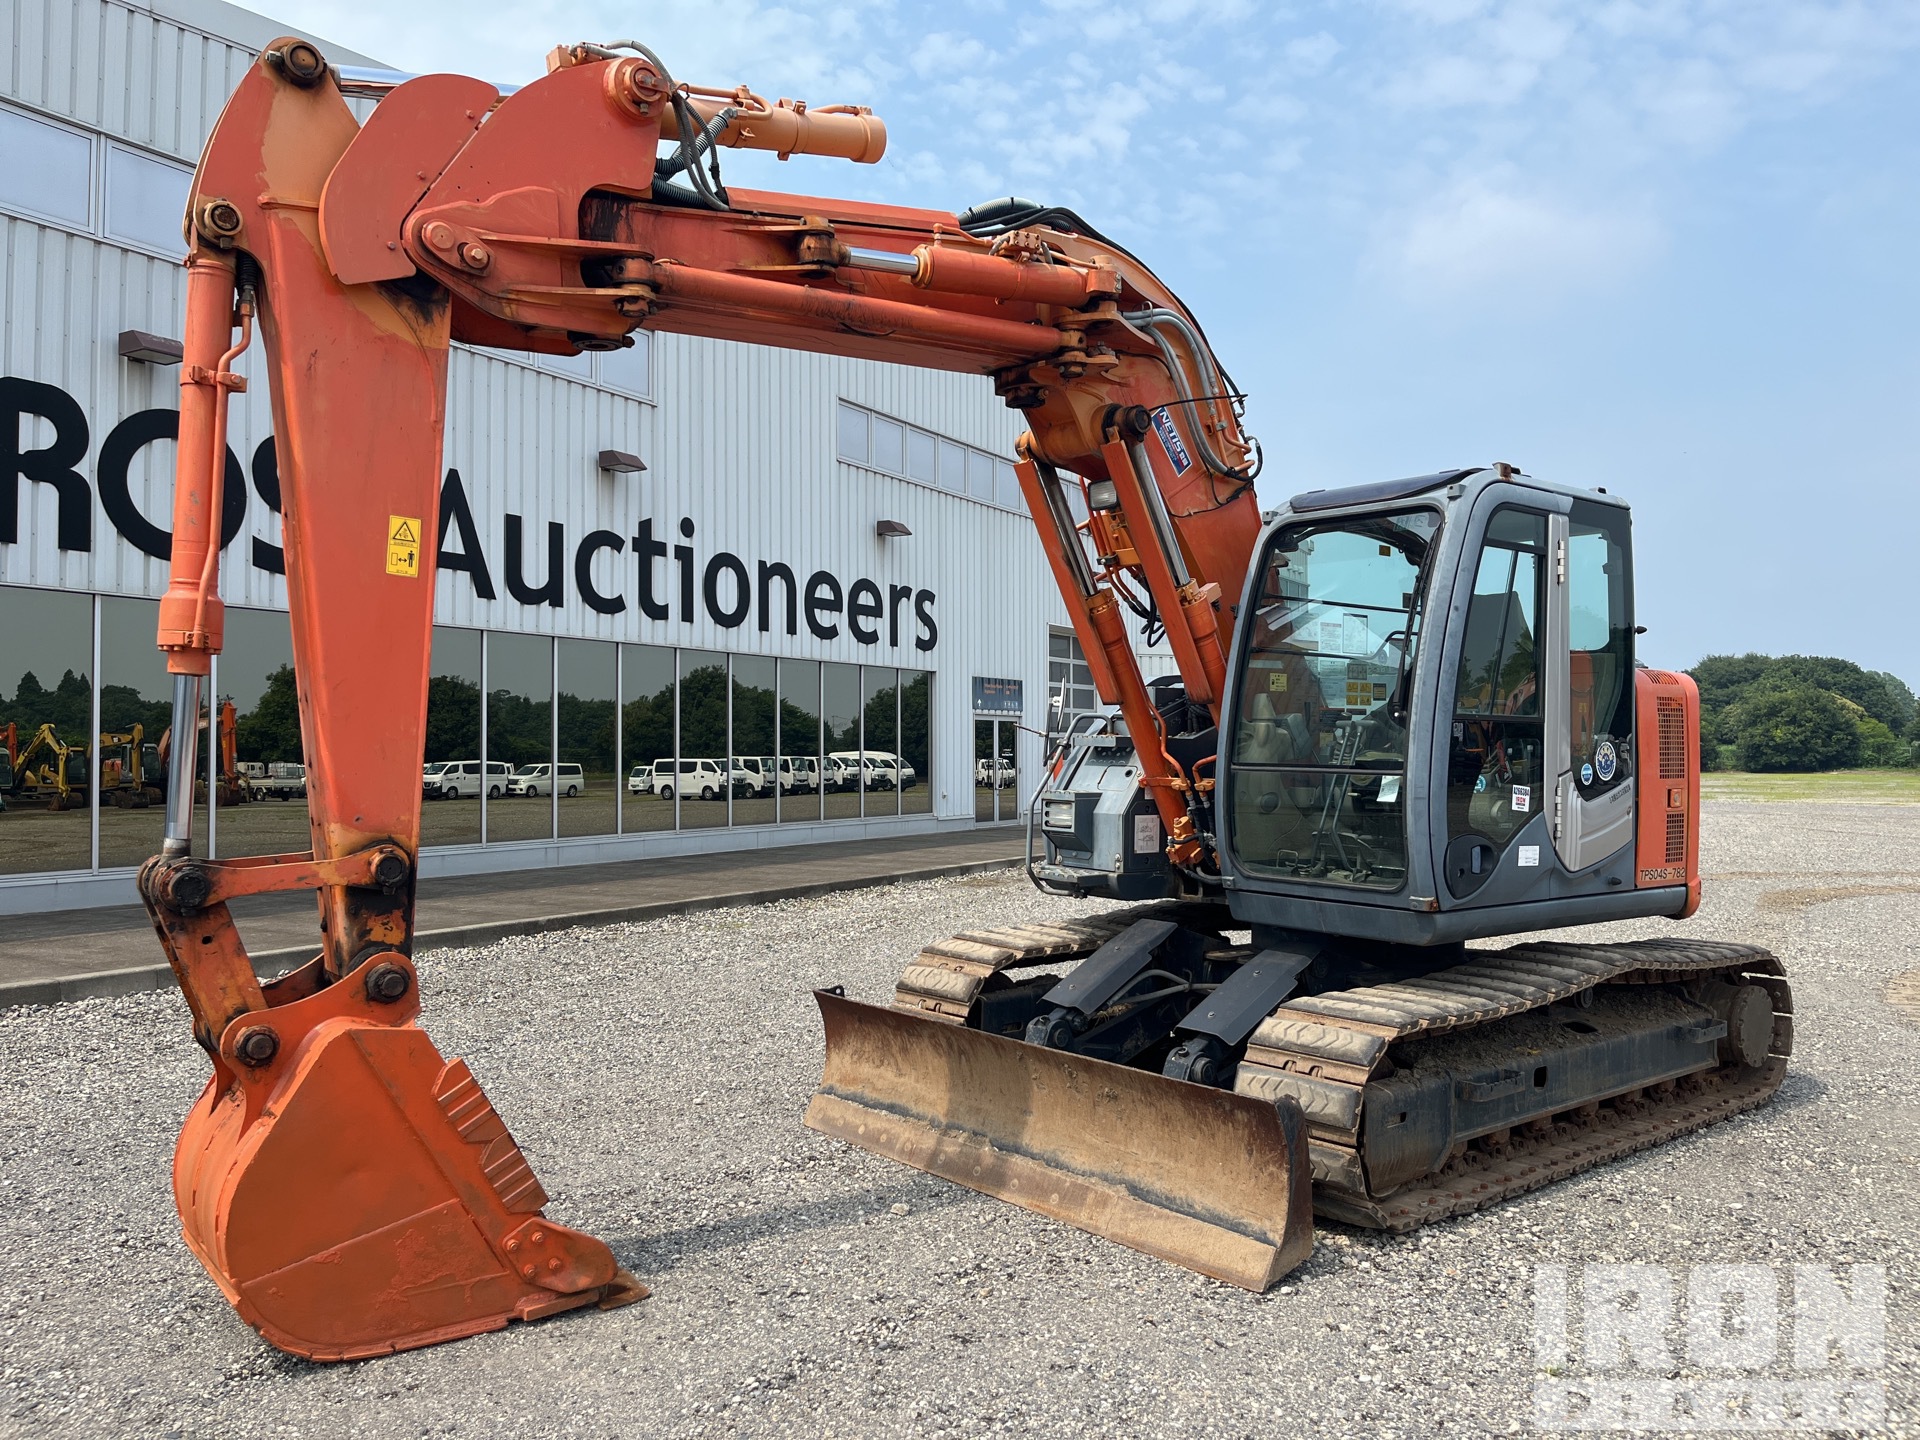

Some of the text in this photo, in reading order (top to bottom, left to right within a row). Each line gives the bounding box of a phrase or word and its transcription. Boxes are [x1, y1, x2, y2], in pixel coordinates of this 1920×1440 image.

[1160, 411, 1183, 452] NETIS
[436, 468, 938, 652] Auctioneers
[1640, 867, 1686, 881] TPS04S-782
